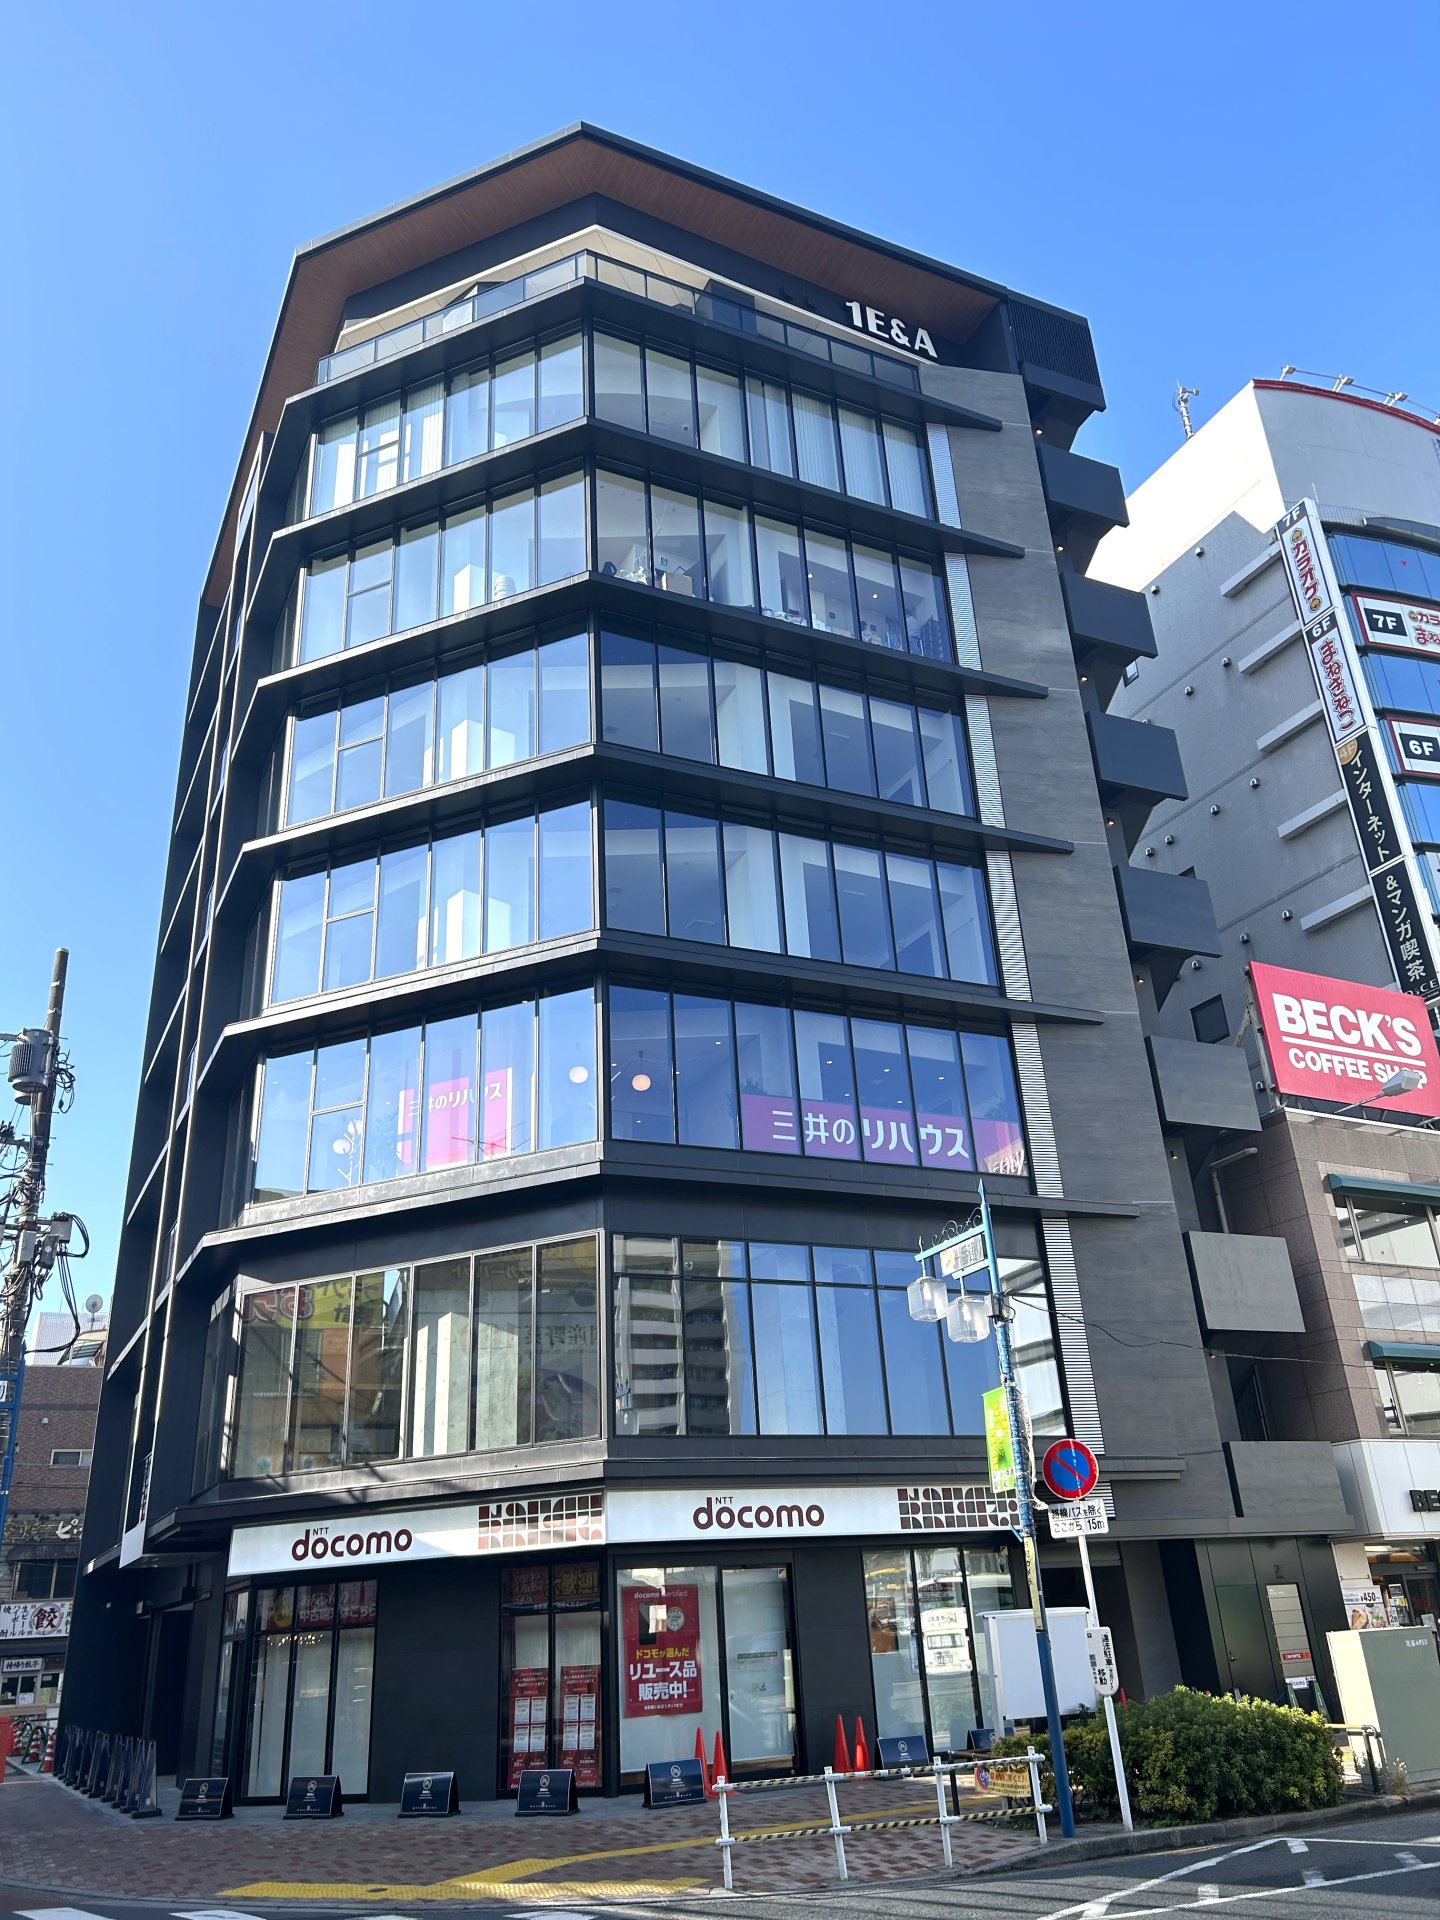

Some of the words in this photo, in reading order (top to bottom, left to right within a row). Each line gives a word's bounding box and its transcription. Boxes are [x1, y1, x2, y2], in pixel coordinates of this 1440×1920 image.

[1282, 505, 1300, 527] 7F
[1291, 538, 1319, 601] カラオケ
[1311, 618, 1331, 638] 6F
[1372, 614, 1397, 630] 7F
[1319, 639, 1358, 731] まねきねこ
[1408, 739, 1434, 756] 6F
[1350, 749, 1391, 864] インターネット
[1271, 992, 1423, 1058] BECK'S
[1288, 1046, 1374, 1081] COFFEE
[1373, 1061, 1428, 1090] SHP
[772, 1110, 970, 1158] 三井のリハウス
[715, 1496, 734, 1505] NTT
[1408, 1489, 1440, 1512] BE
[692, 1496, 825, 1530] docomo
[1051, 1504, 1102, 1520] 路線バスを除く
[55, 1518, 83, 1540] ピ
[312, 1526, 330, 1536] NTT
[1053, 1520, 1083, 1533] ここから
[1087, 1518, 1105, 1531] 15m
[291, 1528, 413, 1562] docomo
[633, 1591, 661, 1599] docomo
[34, 1607, 59, 1630] 餃
[635, 1646, 690, 1660] ドコモが選んだ
[628, 1660, 698, 1681] リユース品
[638, 1681, 688, 1702] 販売中!
